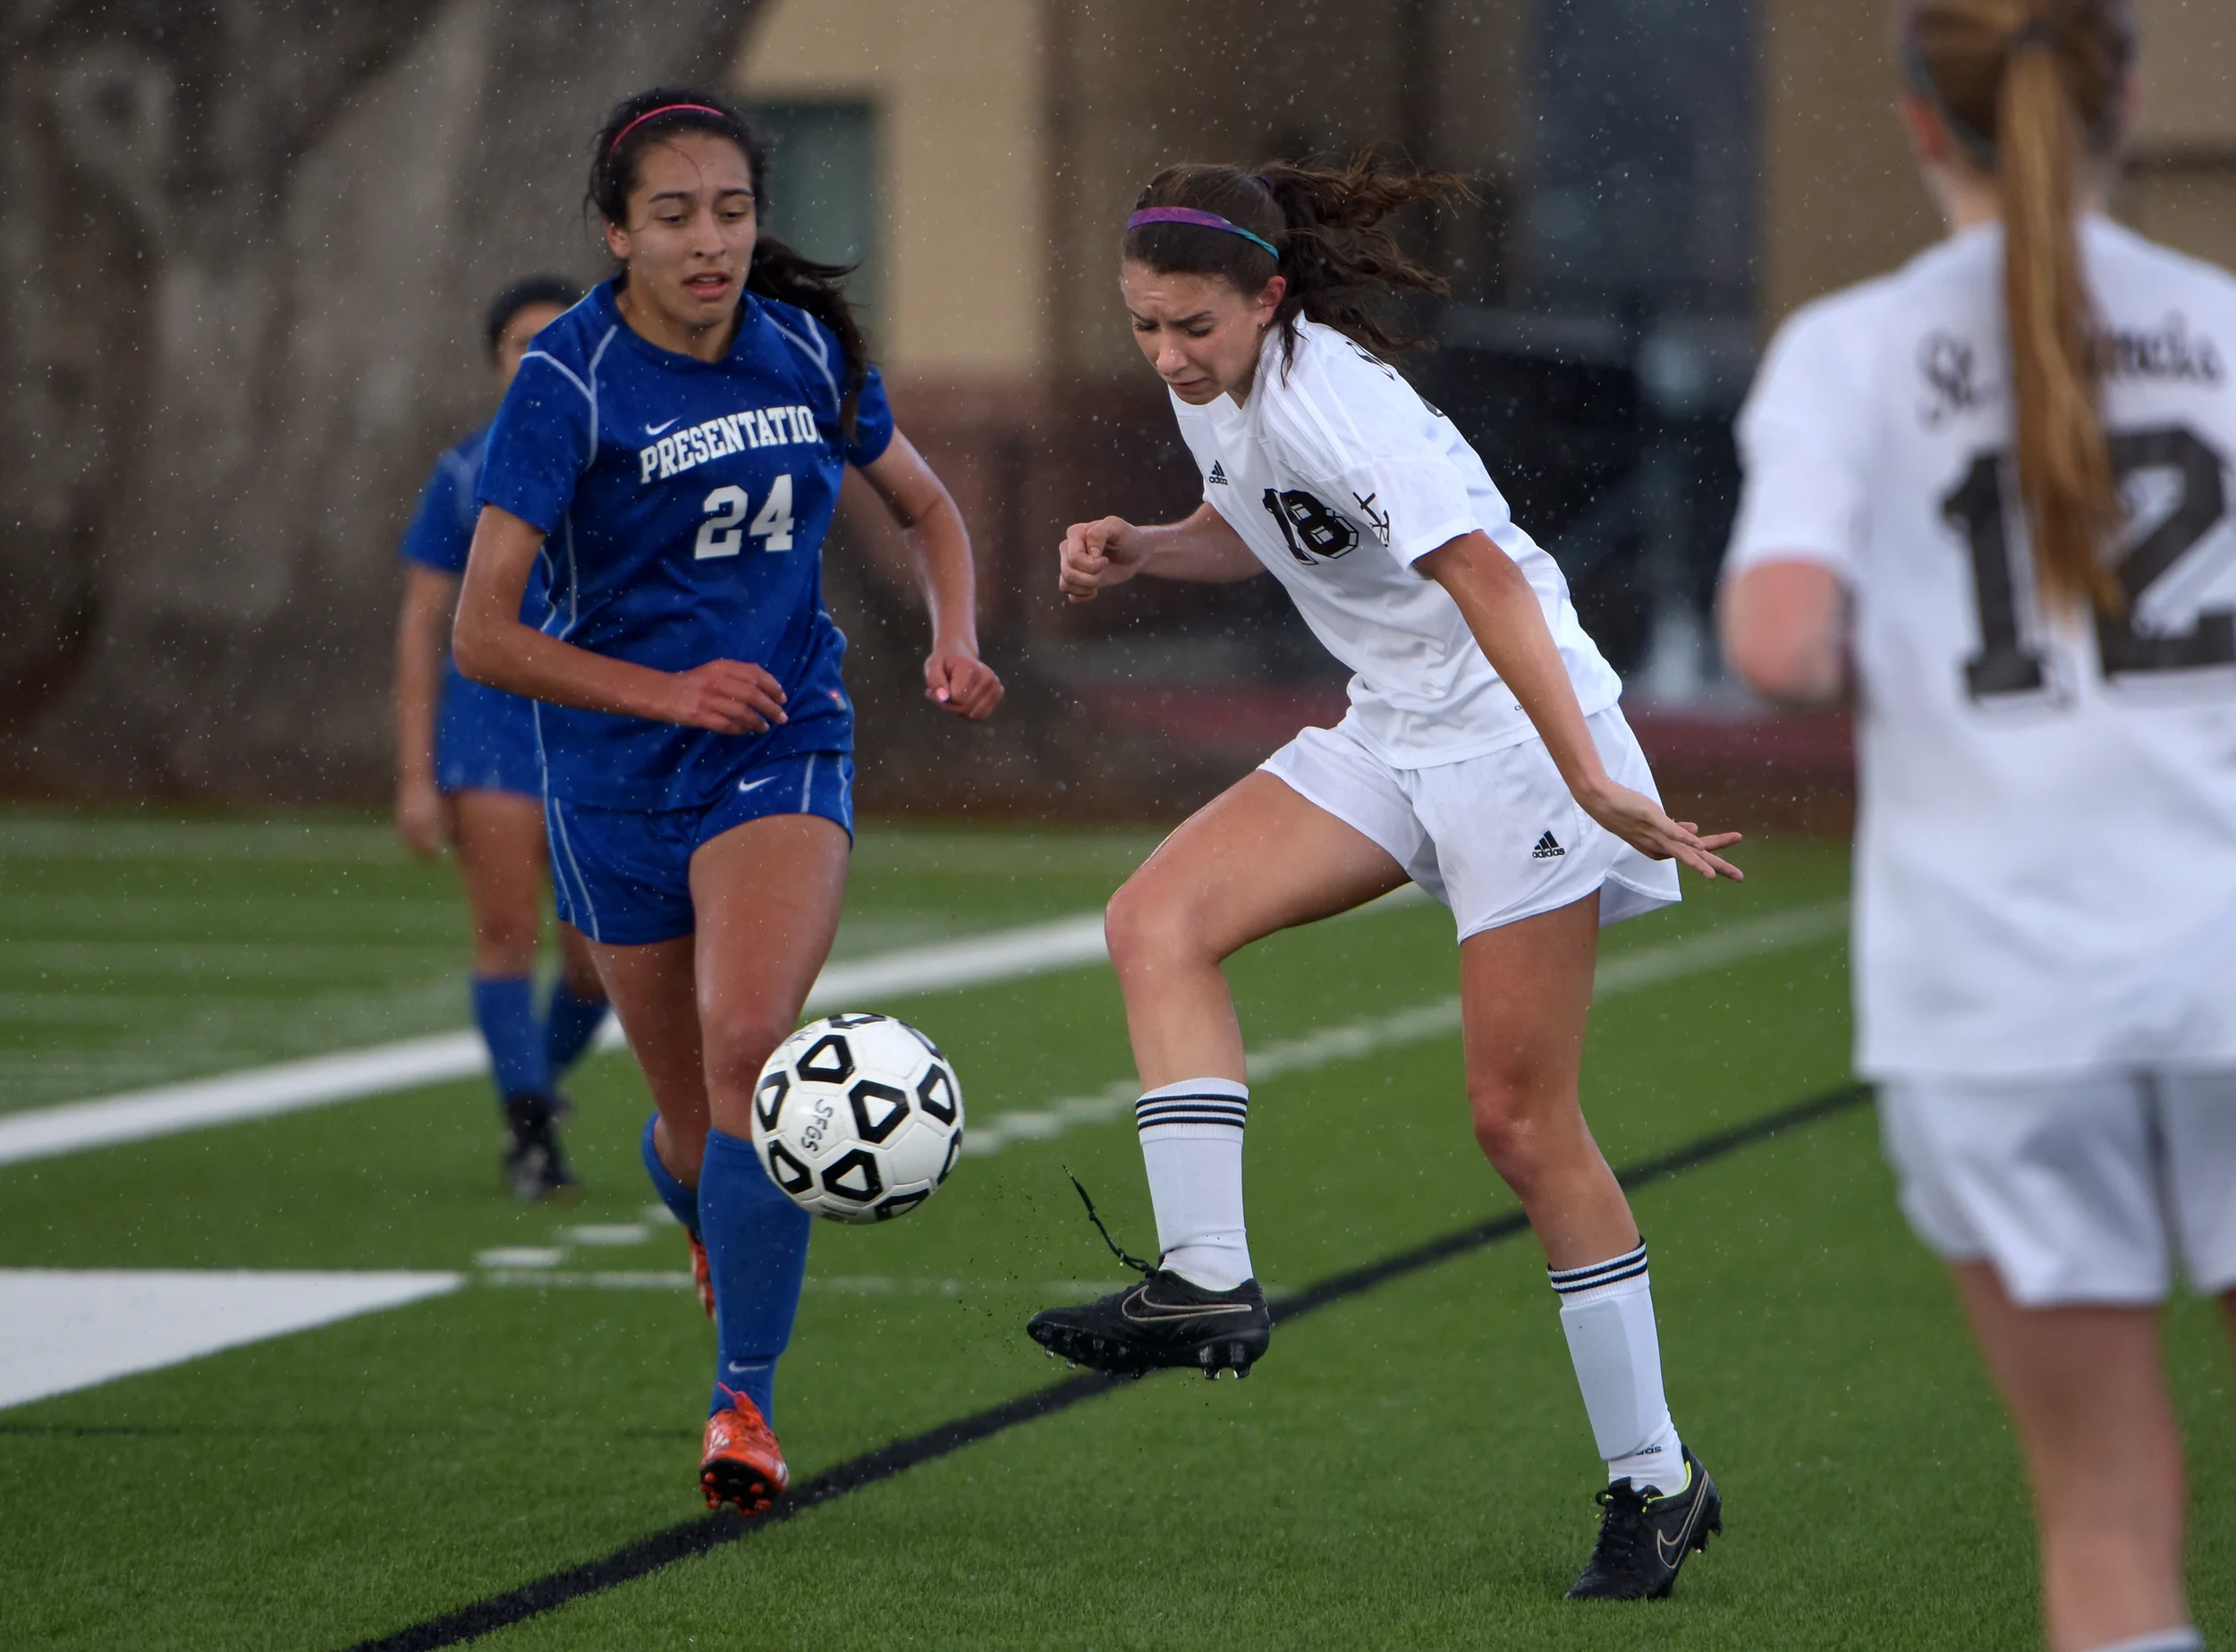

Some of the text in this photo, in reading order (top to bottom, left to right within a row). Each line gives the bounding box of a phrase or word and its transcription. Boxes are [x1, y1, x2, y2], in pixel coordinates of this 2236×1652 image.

[639, 405, 824, 484] PRESENTATIO
[694, 473, 794, 560] 24
[1262, 488, 1359, 565] 18
[1942, 419, 2236, 698] 12
[1532, 848, 1565, 859] adidas
